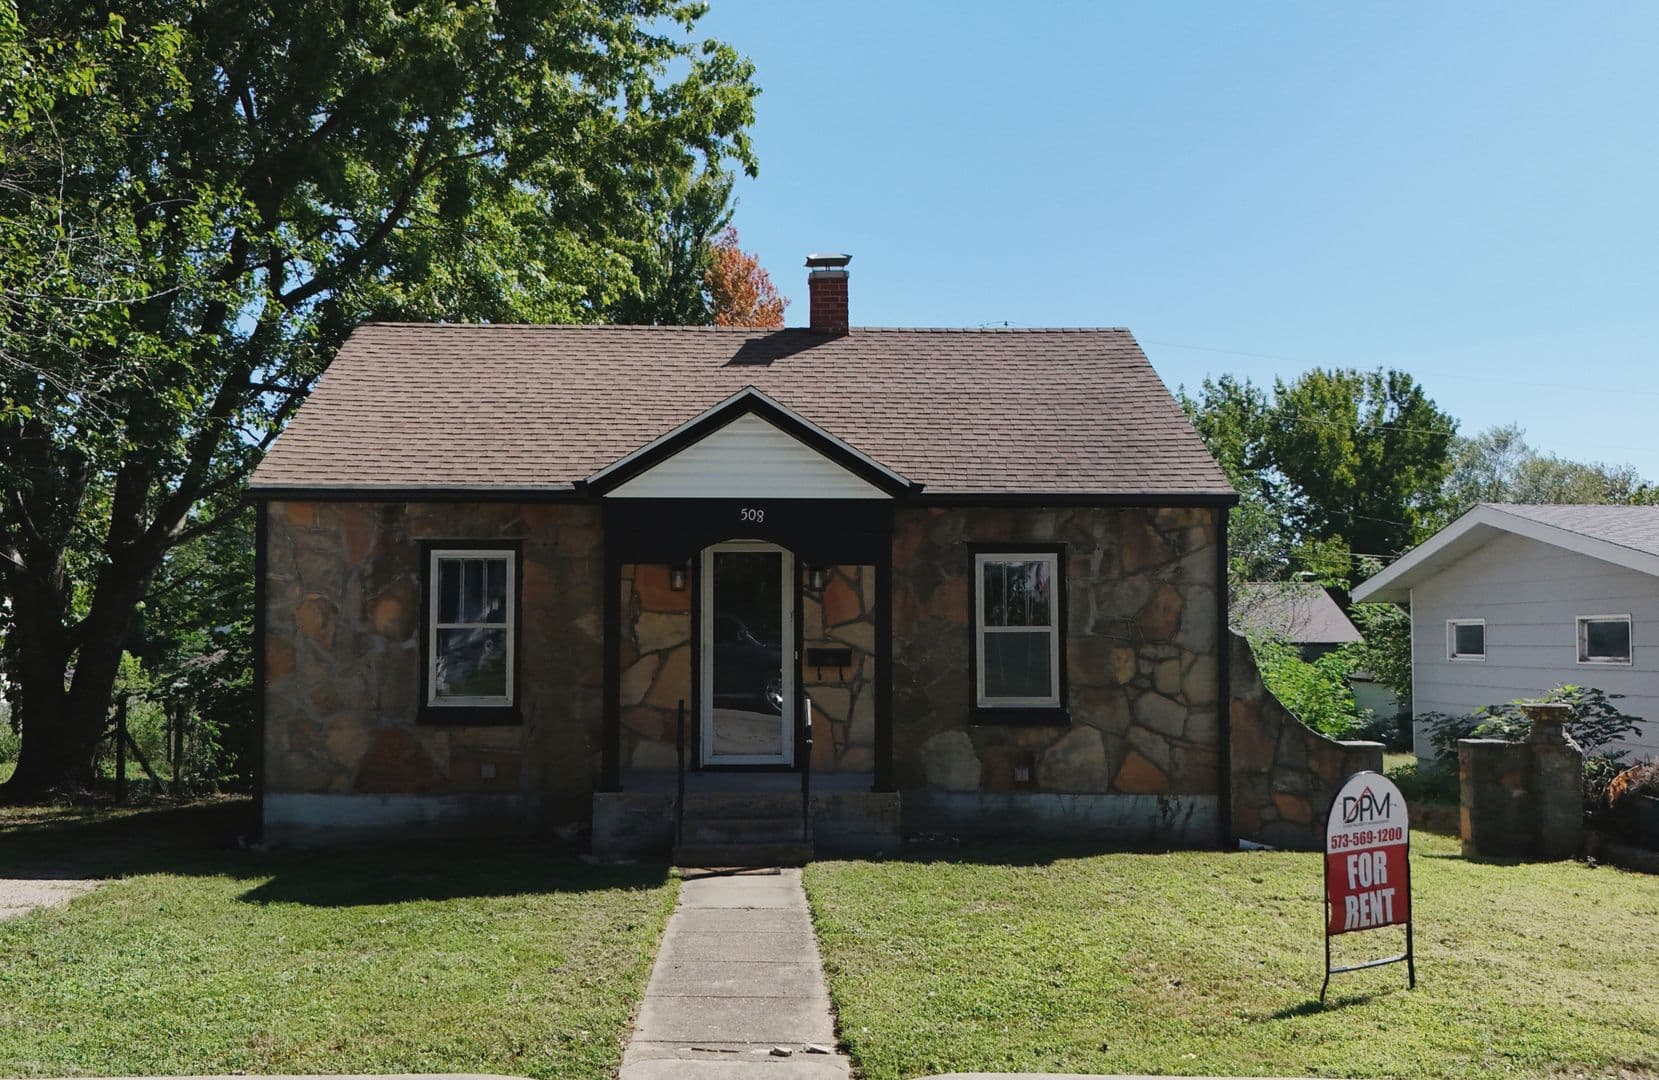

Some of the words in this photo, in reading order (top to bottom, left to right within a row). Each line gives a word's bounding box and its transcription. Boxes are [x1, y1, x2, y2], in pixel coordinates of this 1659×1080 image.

[740, 508, 764, 523] 508
[1331, 827, 1402, 849] 573-569-1200
[1347, 851, 1387, 889] FOR
[1344, 888, 1395, 931] RENT
